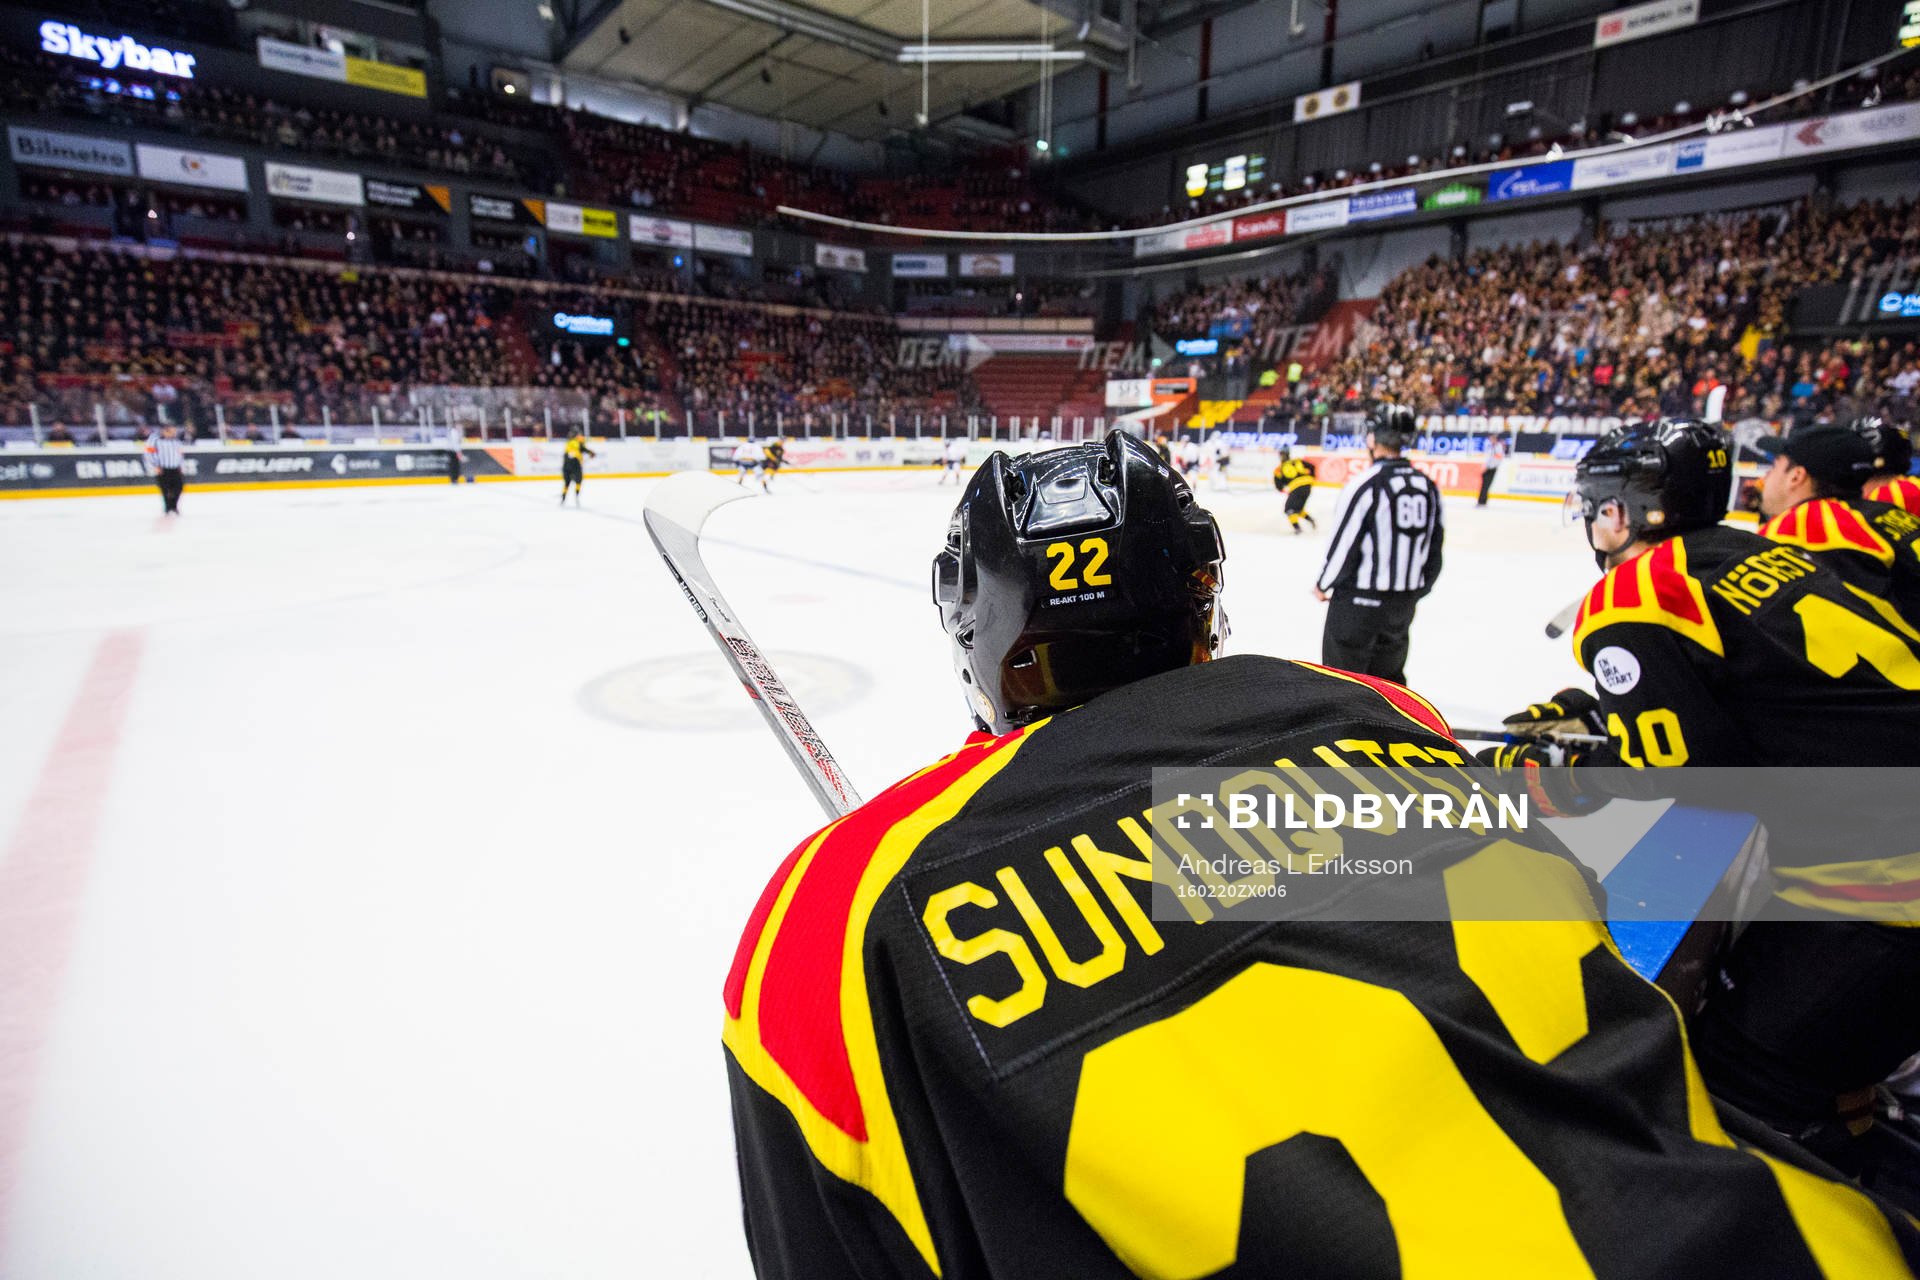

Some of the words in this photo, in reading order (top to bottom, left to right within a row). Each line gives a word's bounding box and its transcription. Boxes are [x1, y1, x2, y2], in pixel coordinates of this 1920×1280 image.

[40, 20, 196, 78] Skybar
[17, 136, 125, 168] Bilmetro
[215, 456, 315, 475] BAUER
[1706, 449, 1728, 469] 10
[1397, 493, 1427, 529] 60
[1046, 537, 1112, 591] 22
[1049, 595, 1077, 606] RE-AKT
[1079, 592, 1095, 602] 100
[1096, 590, 1105, 599] M
[1606, 671, 1633, 688] START
[1606, 707, 1690, 771] 10
